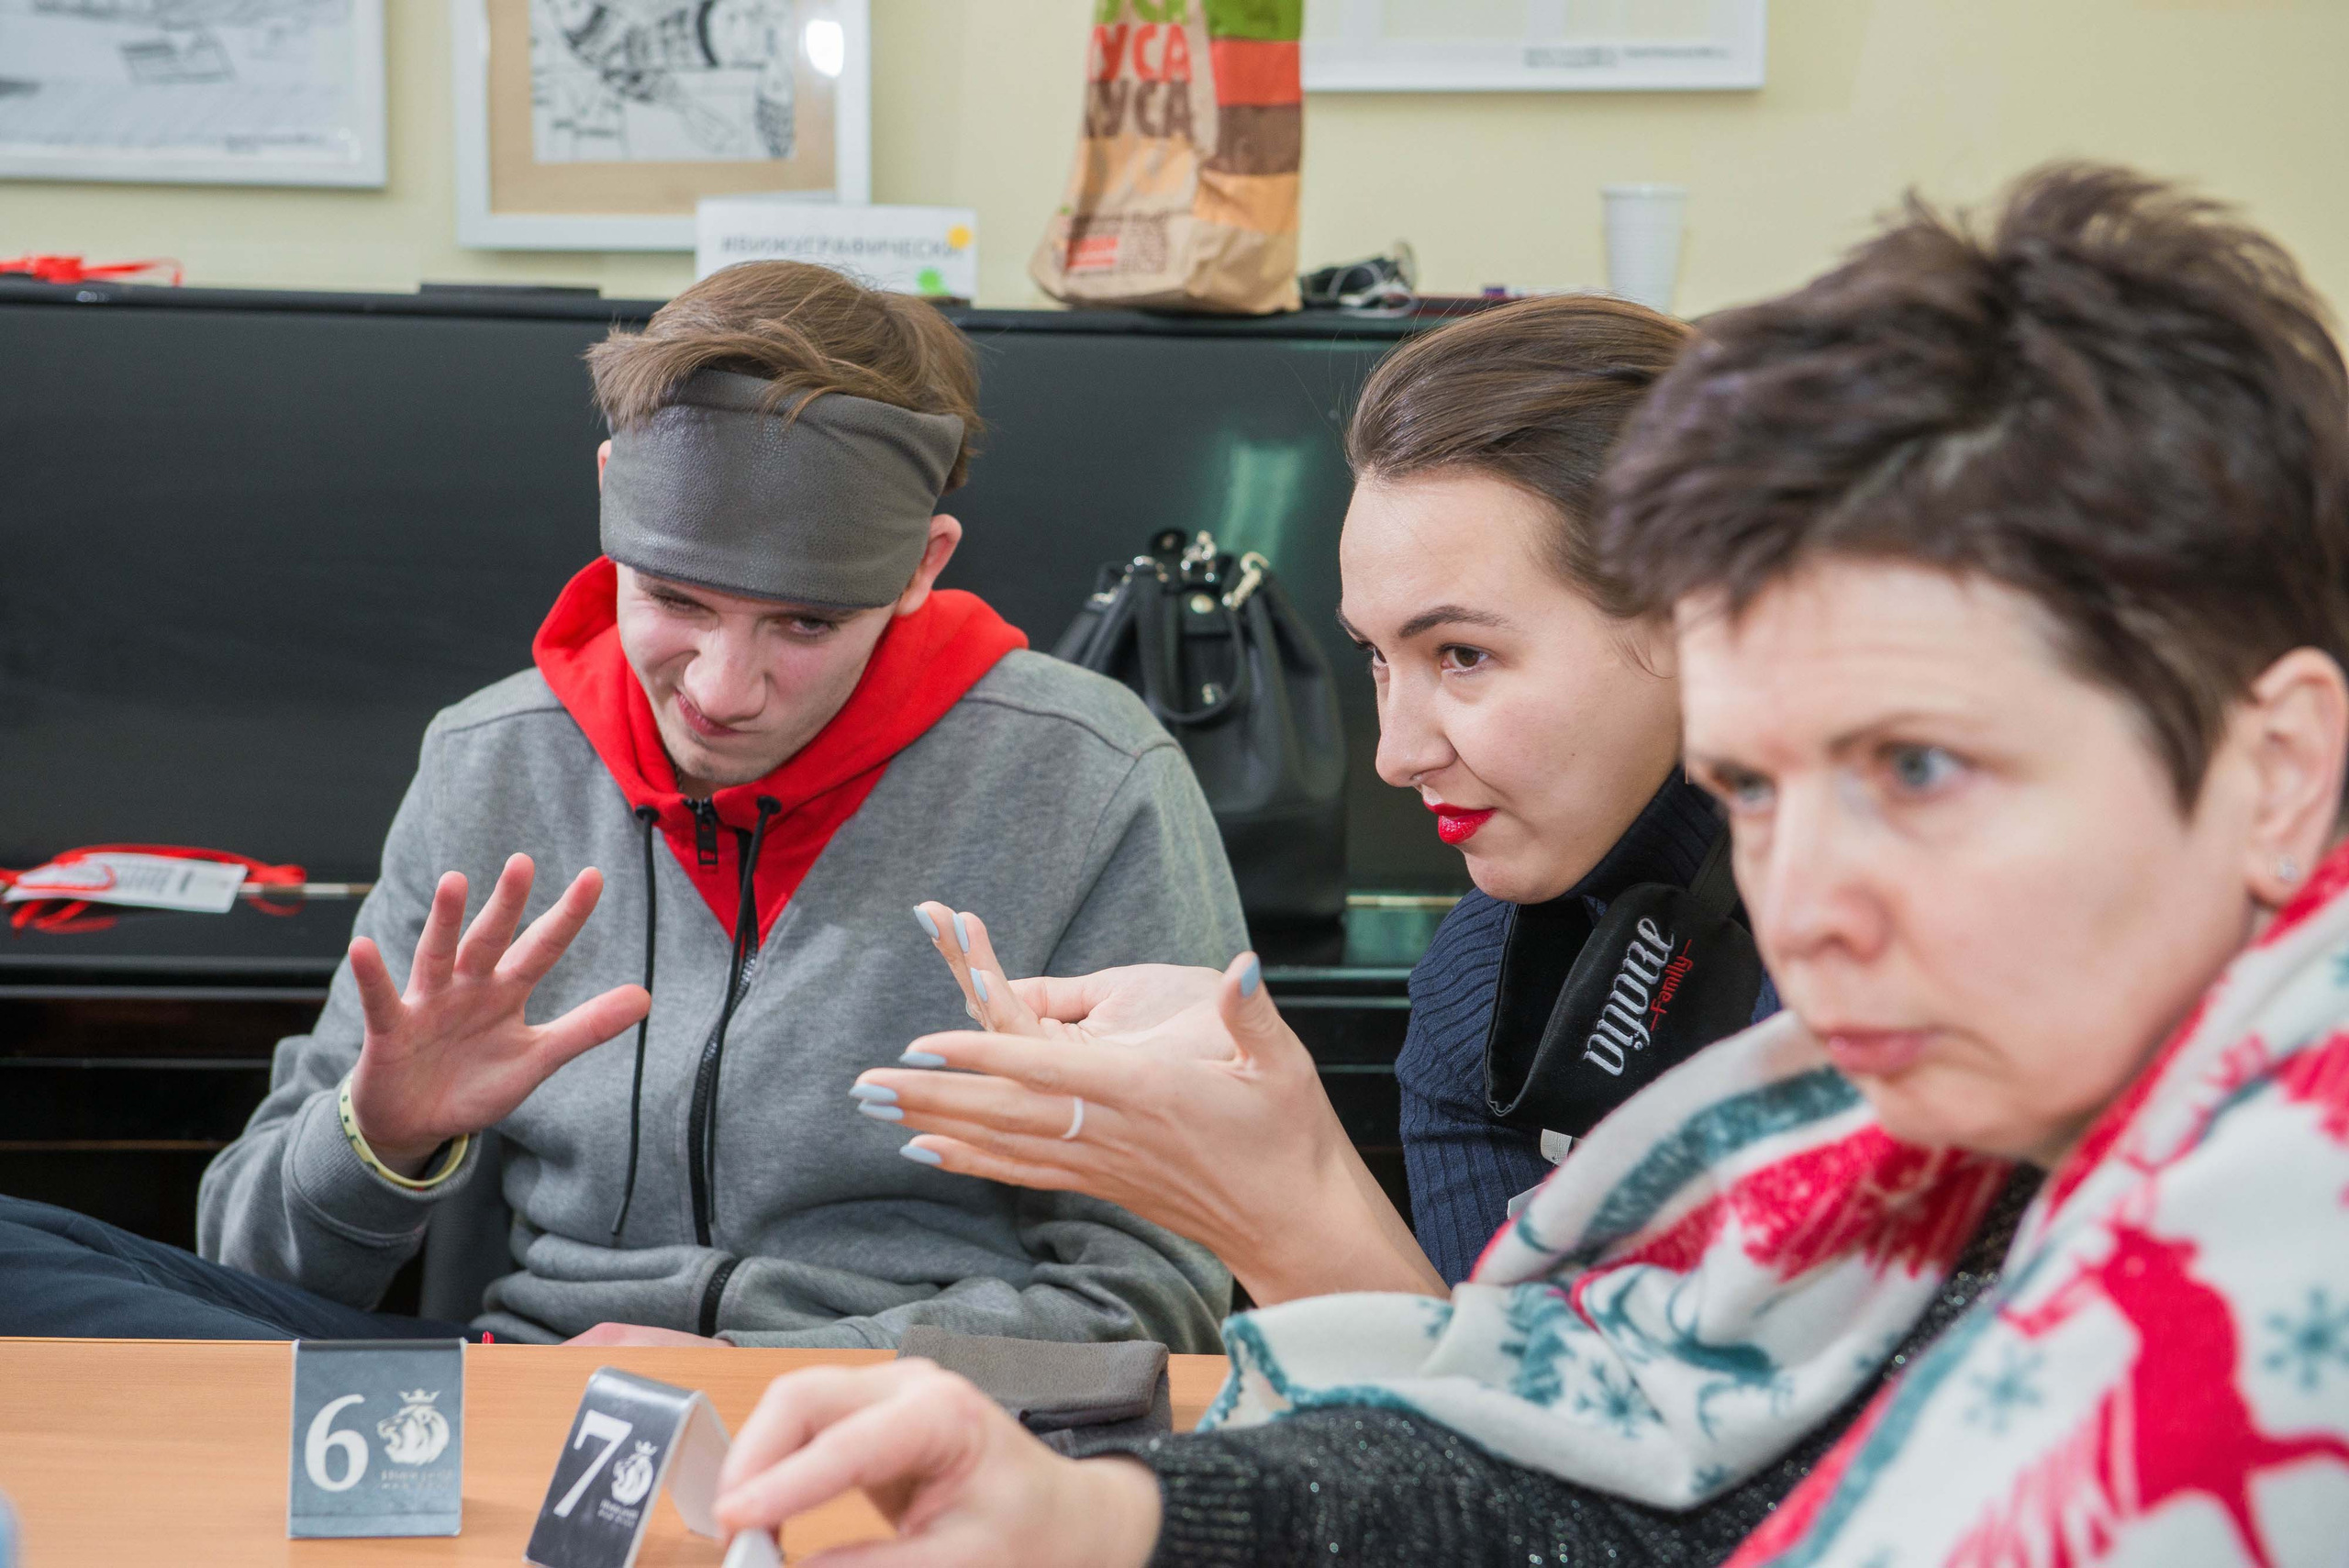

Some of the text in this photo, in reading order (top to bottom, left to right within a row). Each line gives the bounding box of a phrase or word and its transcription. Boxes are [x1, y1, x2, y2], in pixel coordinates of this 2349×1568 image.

[1086, 23, 1192, 83] УСА
[1650, 954, 1694, 1015] Family
[305, 1394, 369, 1492] 6
[553, 1409, 633, 1518] 7
